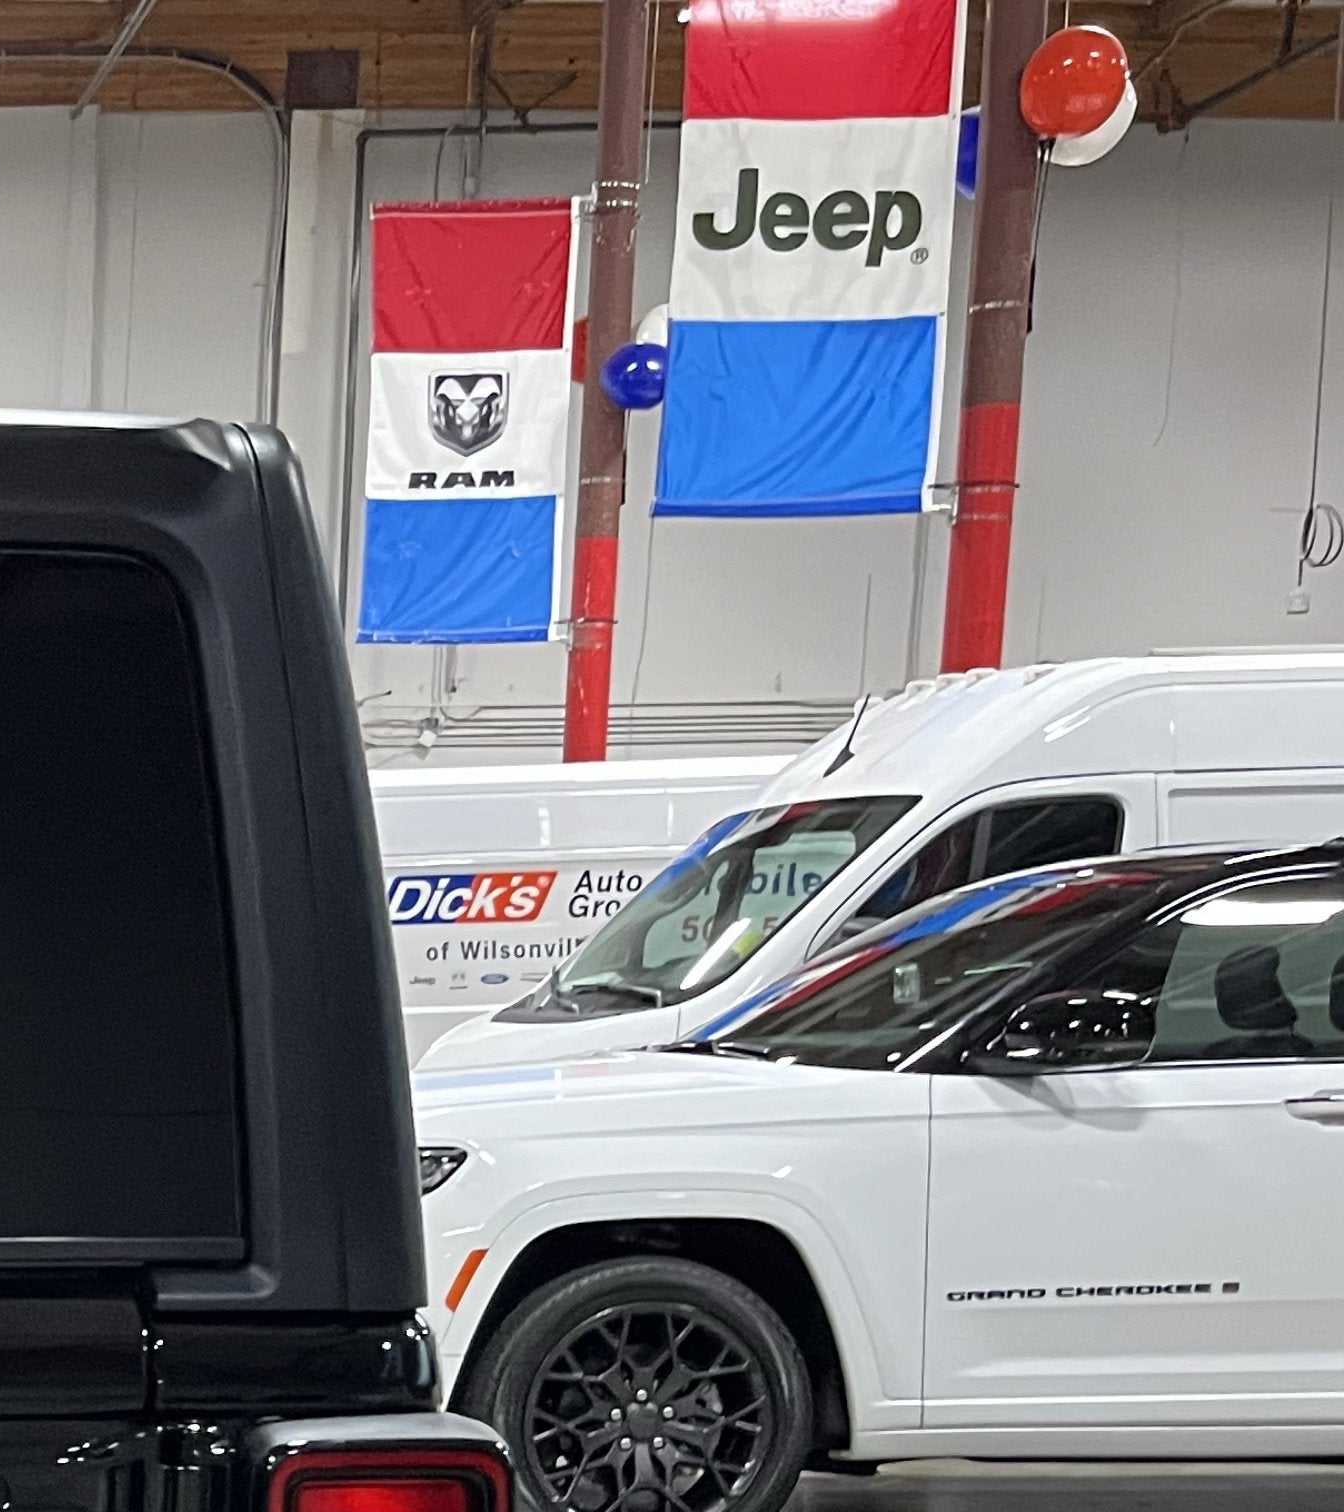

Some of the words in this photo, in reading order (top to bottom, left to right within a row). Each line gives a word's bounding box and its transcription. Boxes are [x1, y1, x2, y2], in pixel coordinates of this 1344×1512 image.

[692, 168, 923, 268] Jeep
[407, 469, 516, 491] RAM
[389, 876, 541, 921] Dick's
[574, 870, 643, 894] Auto
[568, 894, 621, 919] Gro
[426, 941, 449, 961] of
[461, 936, 585, 961] Wilsonvil
[946, 1287, 1047, 1302] GRAND
[1055, 1282, 1212, 1299] CHEROKEE
